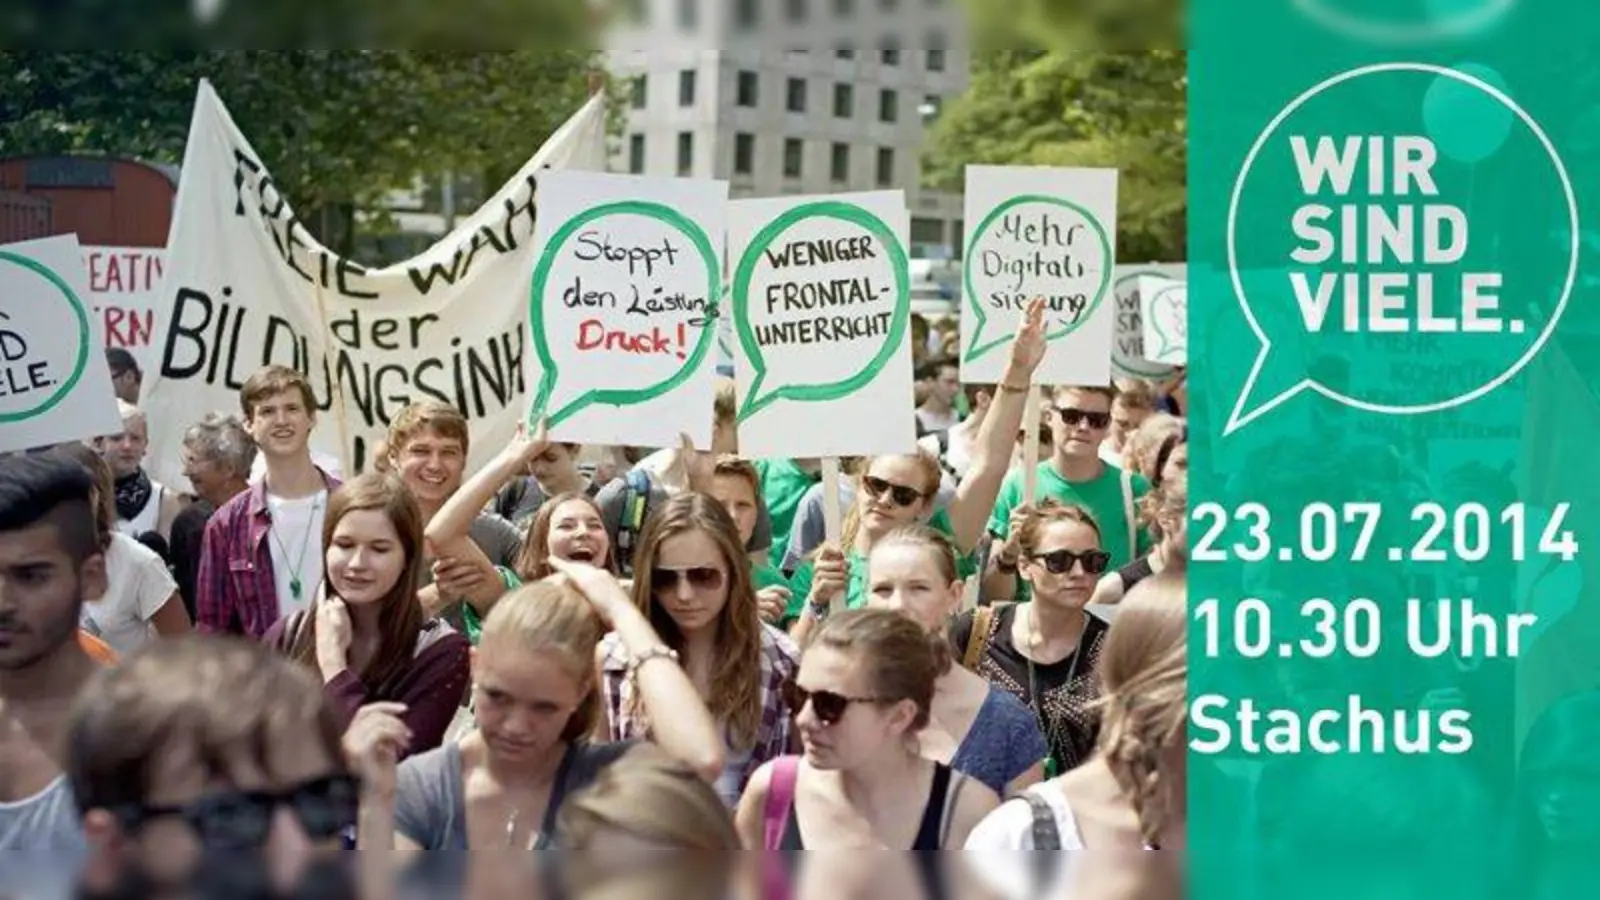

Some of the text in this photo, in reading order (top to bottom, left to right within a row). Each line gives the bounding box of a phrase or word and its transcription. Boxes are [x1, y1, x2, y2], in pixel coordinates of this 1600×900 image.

[408, 175, 538, 294] WAH
[996, 214, 1084, 246] Mehr
[574, 231, 678, 277] Stoppt
[765, 235, 876, 269] WENIGER
[88, 253, 163, 292] EATI
[563, 277, 616, 309] den
[765, 278, 891, 314] FRONTAL-
[990, 292, 1087, 325] sieung
[331, 309, 440, 350] der
[576, 319, 687, 360] Druck!
[755, 312, 892, 346] UNTERRICHT
